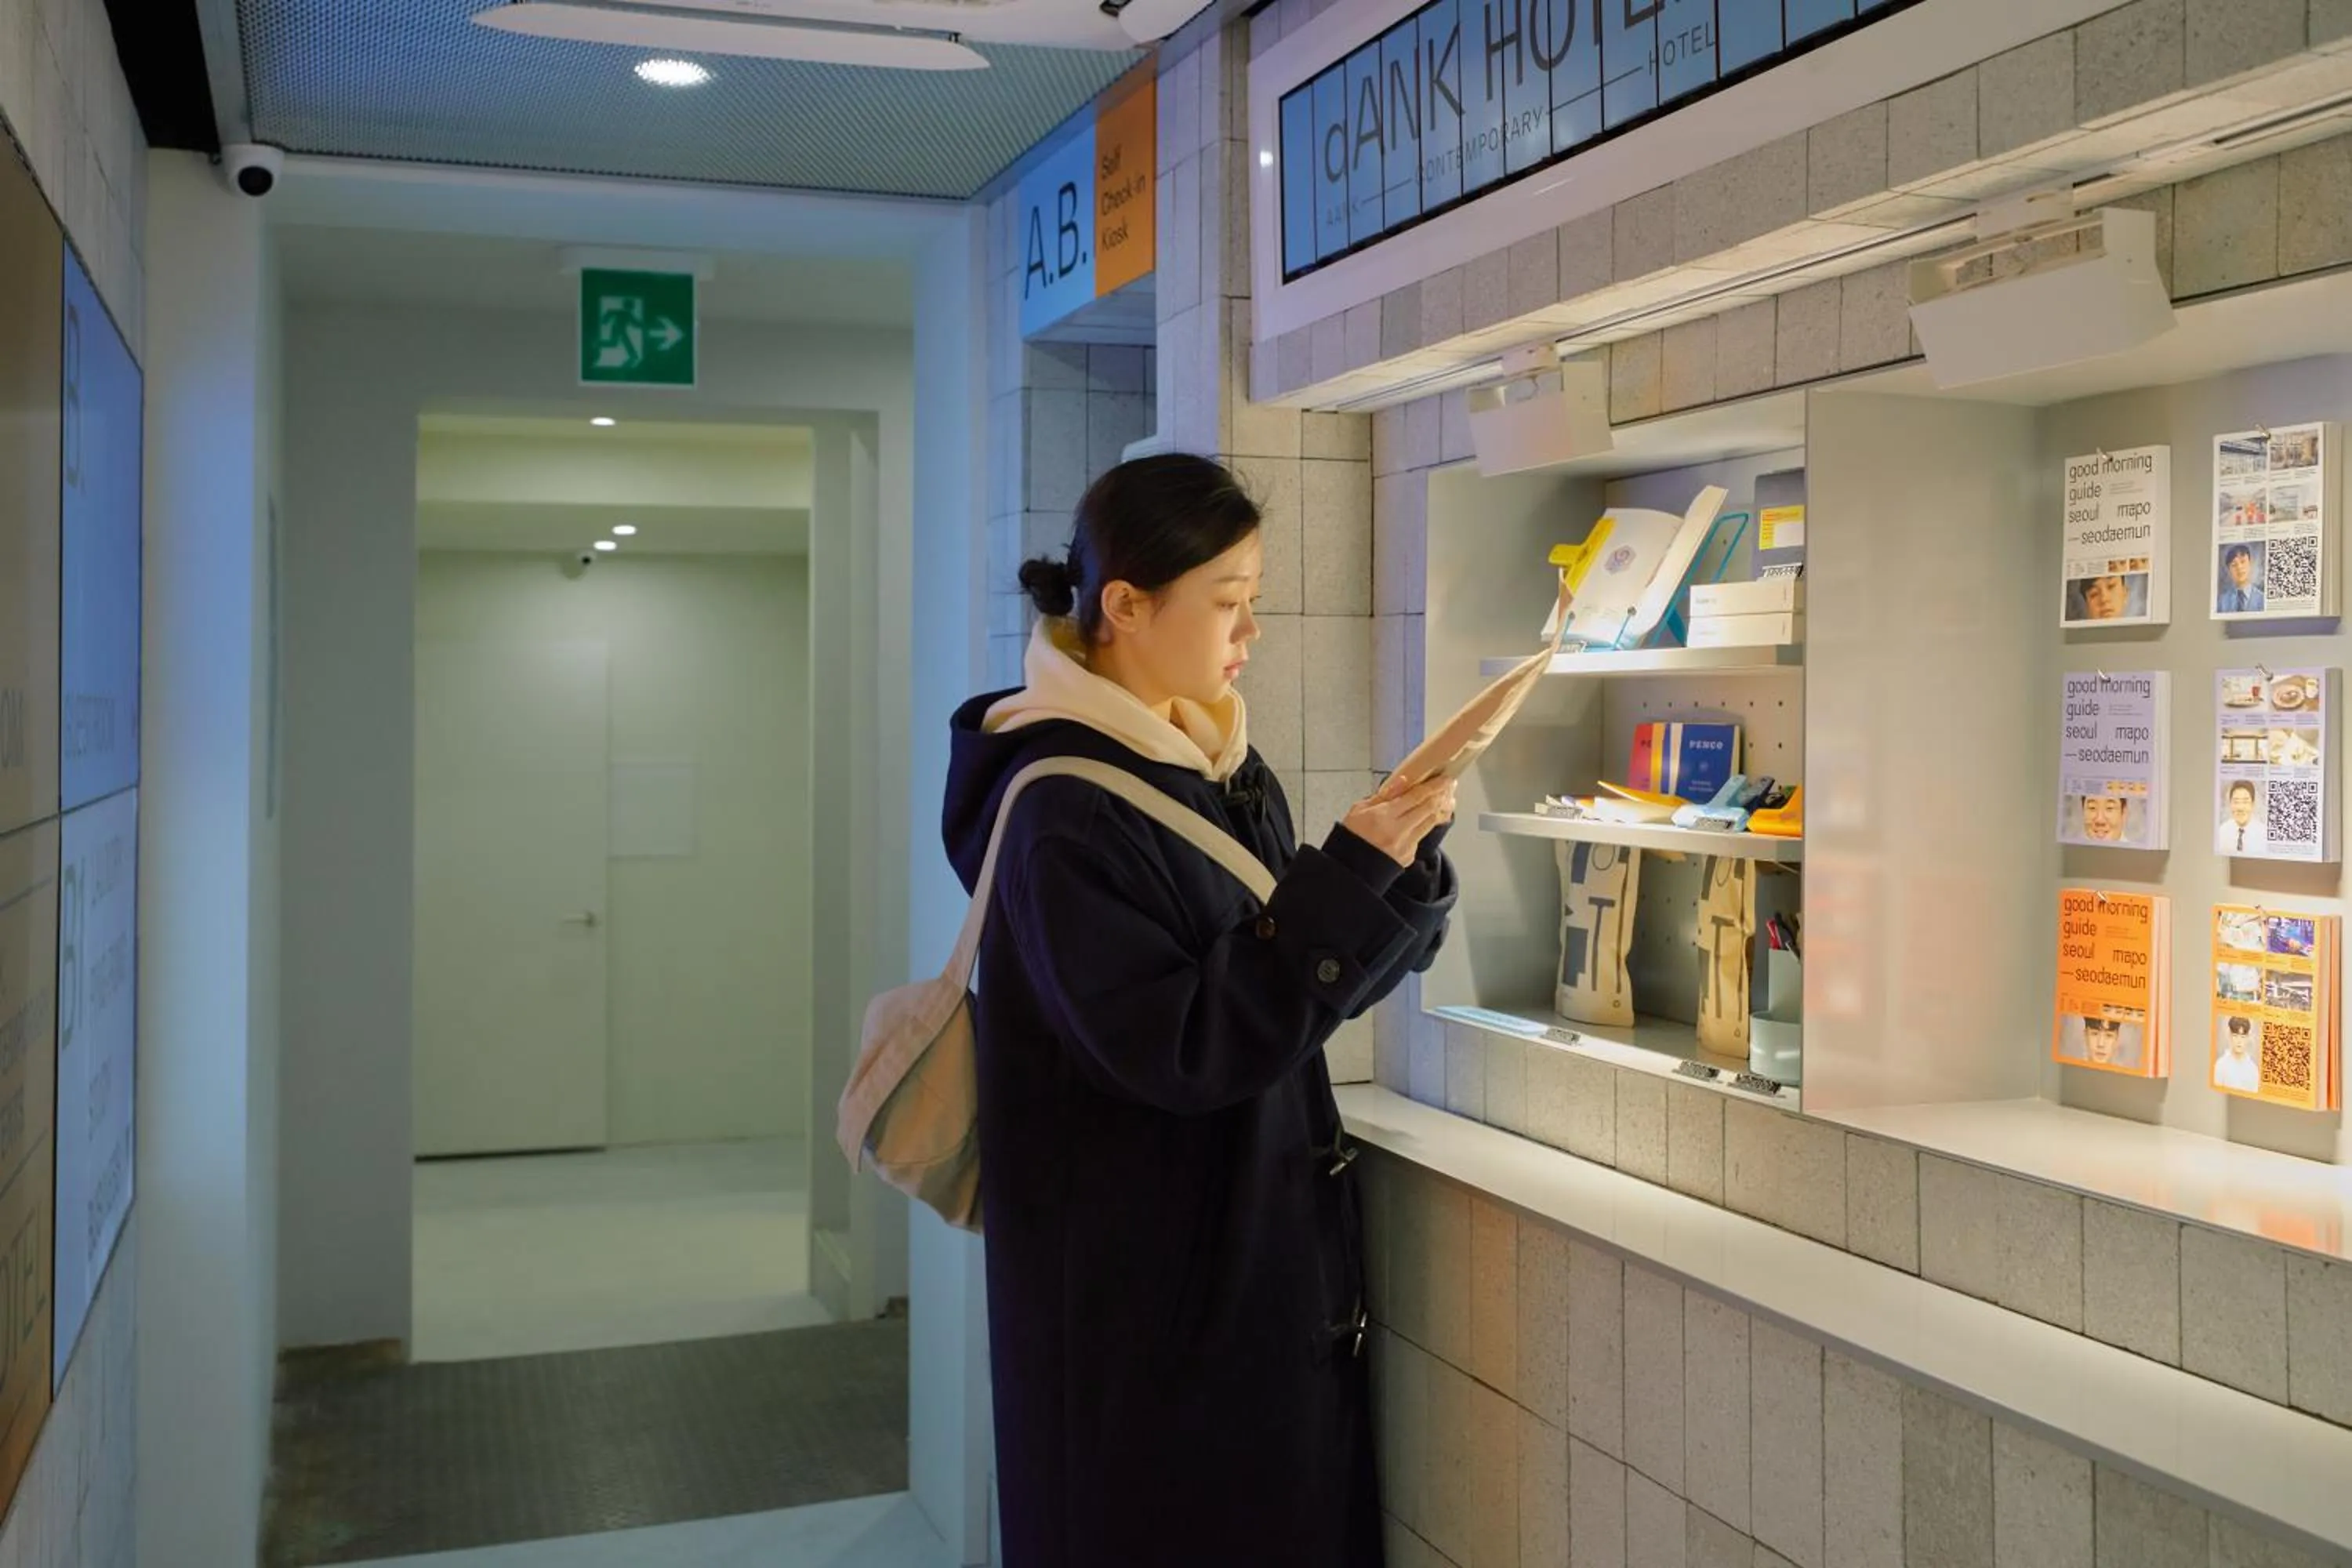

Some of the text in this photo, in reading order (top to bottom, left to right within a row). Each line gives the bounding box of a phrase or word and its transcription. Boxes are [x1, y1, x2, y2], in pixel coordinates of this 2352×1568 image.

[1416, 106, 1543, 187] CONTEMPORARY
[1649, 21, 1715, 75] HOTEL
[1025, 181, 1087, 301] A.B.
[1102, 215, 1129, 251] Kiosk
[2069, 452, 2152, 484] good morning
[2069, 481, 2102, 506] guide
[2069, 501, 2151, 524] seoul mapo
[2067, 676, 2151, 699] good morning
[2066, 700, 2100, 721] guide
[1689, 739, 1724, 750] PENCO
[2066, 721, 2149, 745] seoul mapo
[2064, 896, 2148, 924] good morning
[2063, 918, 2097, 939] guide
[2063, 942, 2147, 969] seoul mapo
